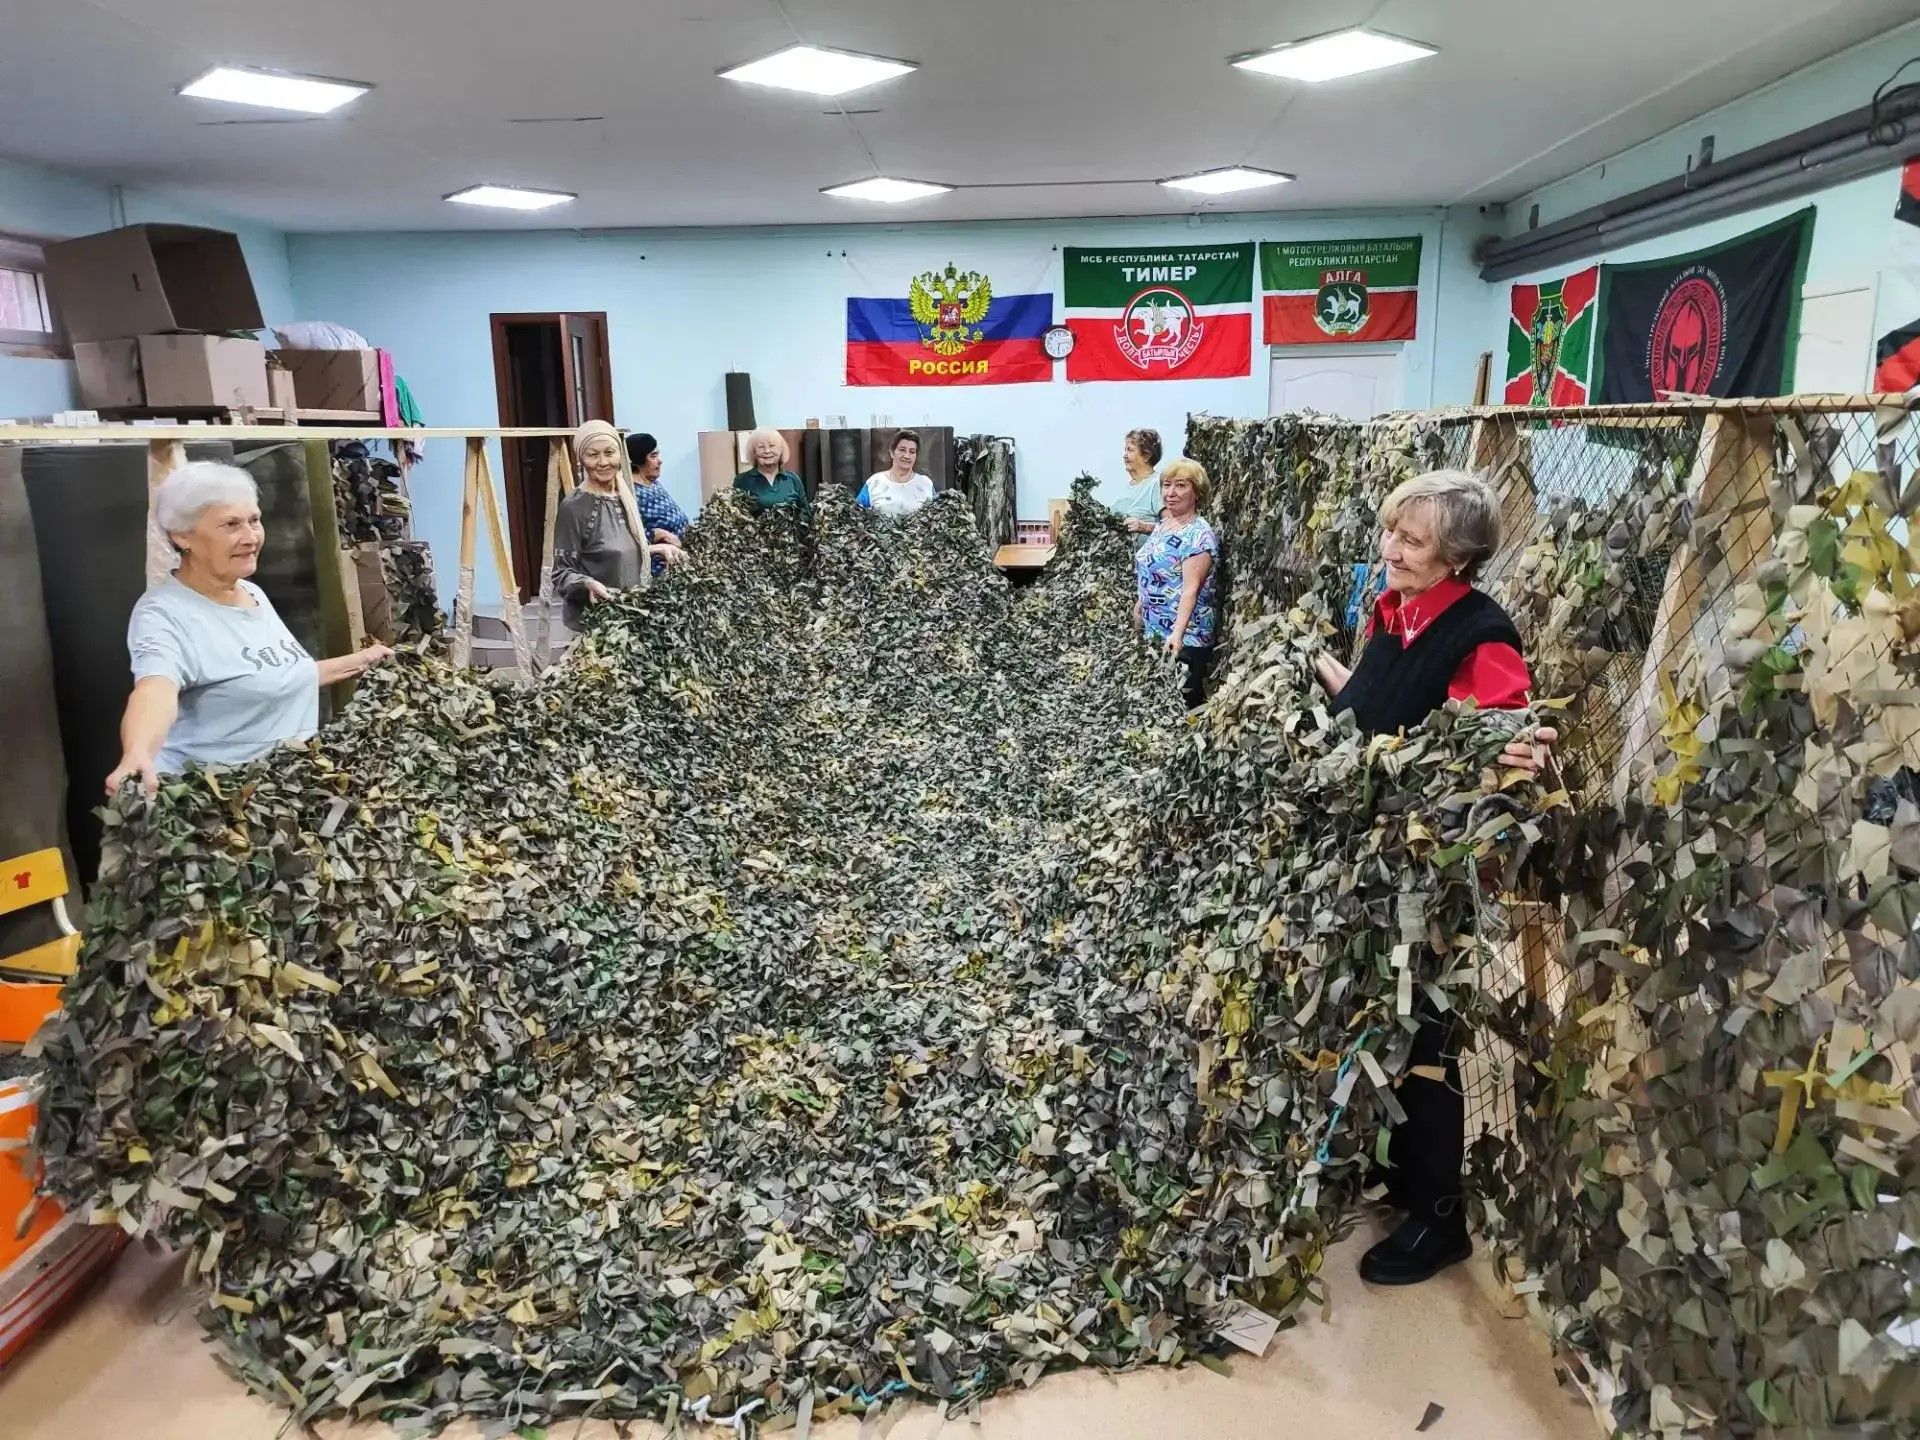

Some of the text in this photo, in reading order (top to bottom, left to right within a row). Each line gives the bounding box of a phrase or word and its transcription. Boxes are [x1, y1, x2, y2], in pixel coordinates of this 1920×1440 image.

[1080, 251, 1240, 264] МСБ РЕСПУБЛИКА ТАТАРСТАН
[1289, 254, 1398, 267] РЕСПУБЛИКИ ТАТАРСТАН
[1122, 265, 1197, 282] ТИМЕР
[1325, 270, 1362, 283] АЛГА
[1117, 335, 1140, 359] ДОЛГ
[1178, 331, 1200, 358] ЧЕСТЬ
[909, 359, 989, 375] РОССИЯ
